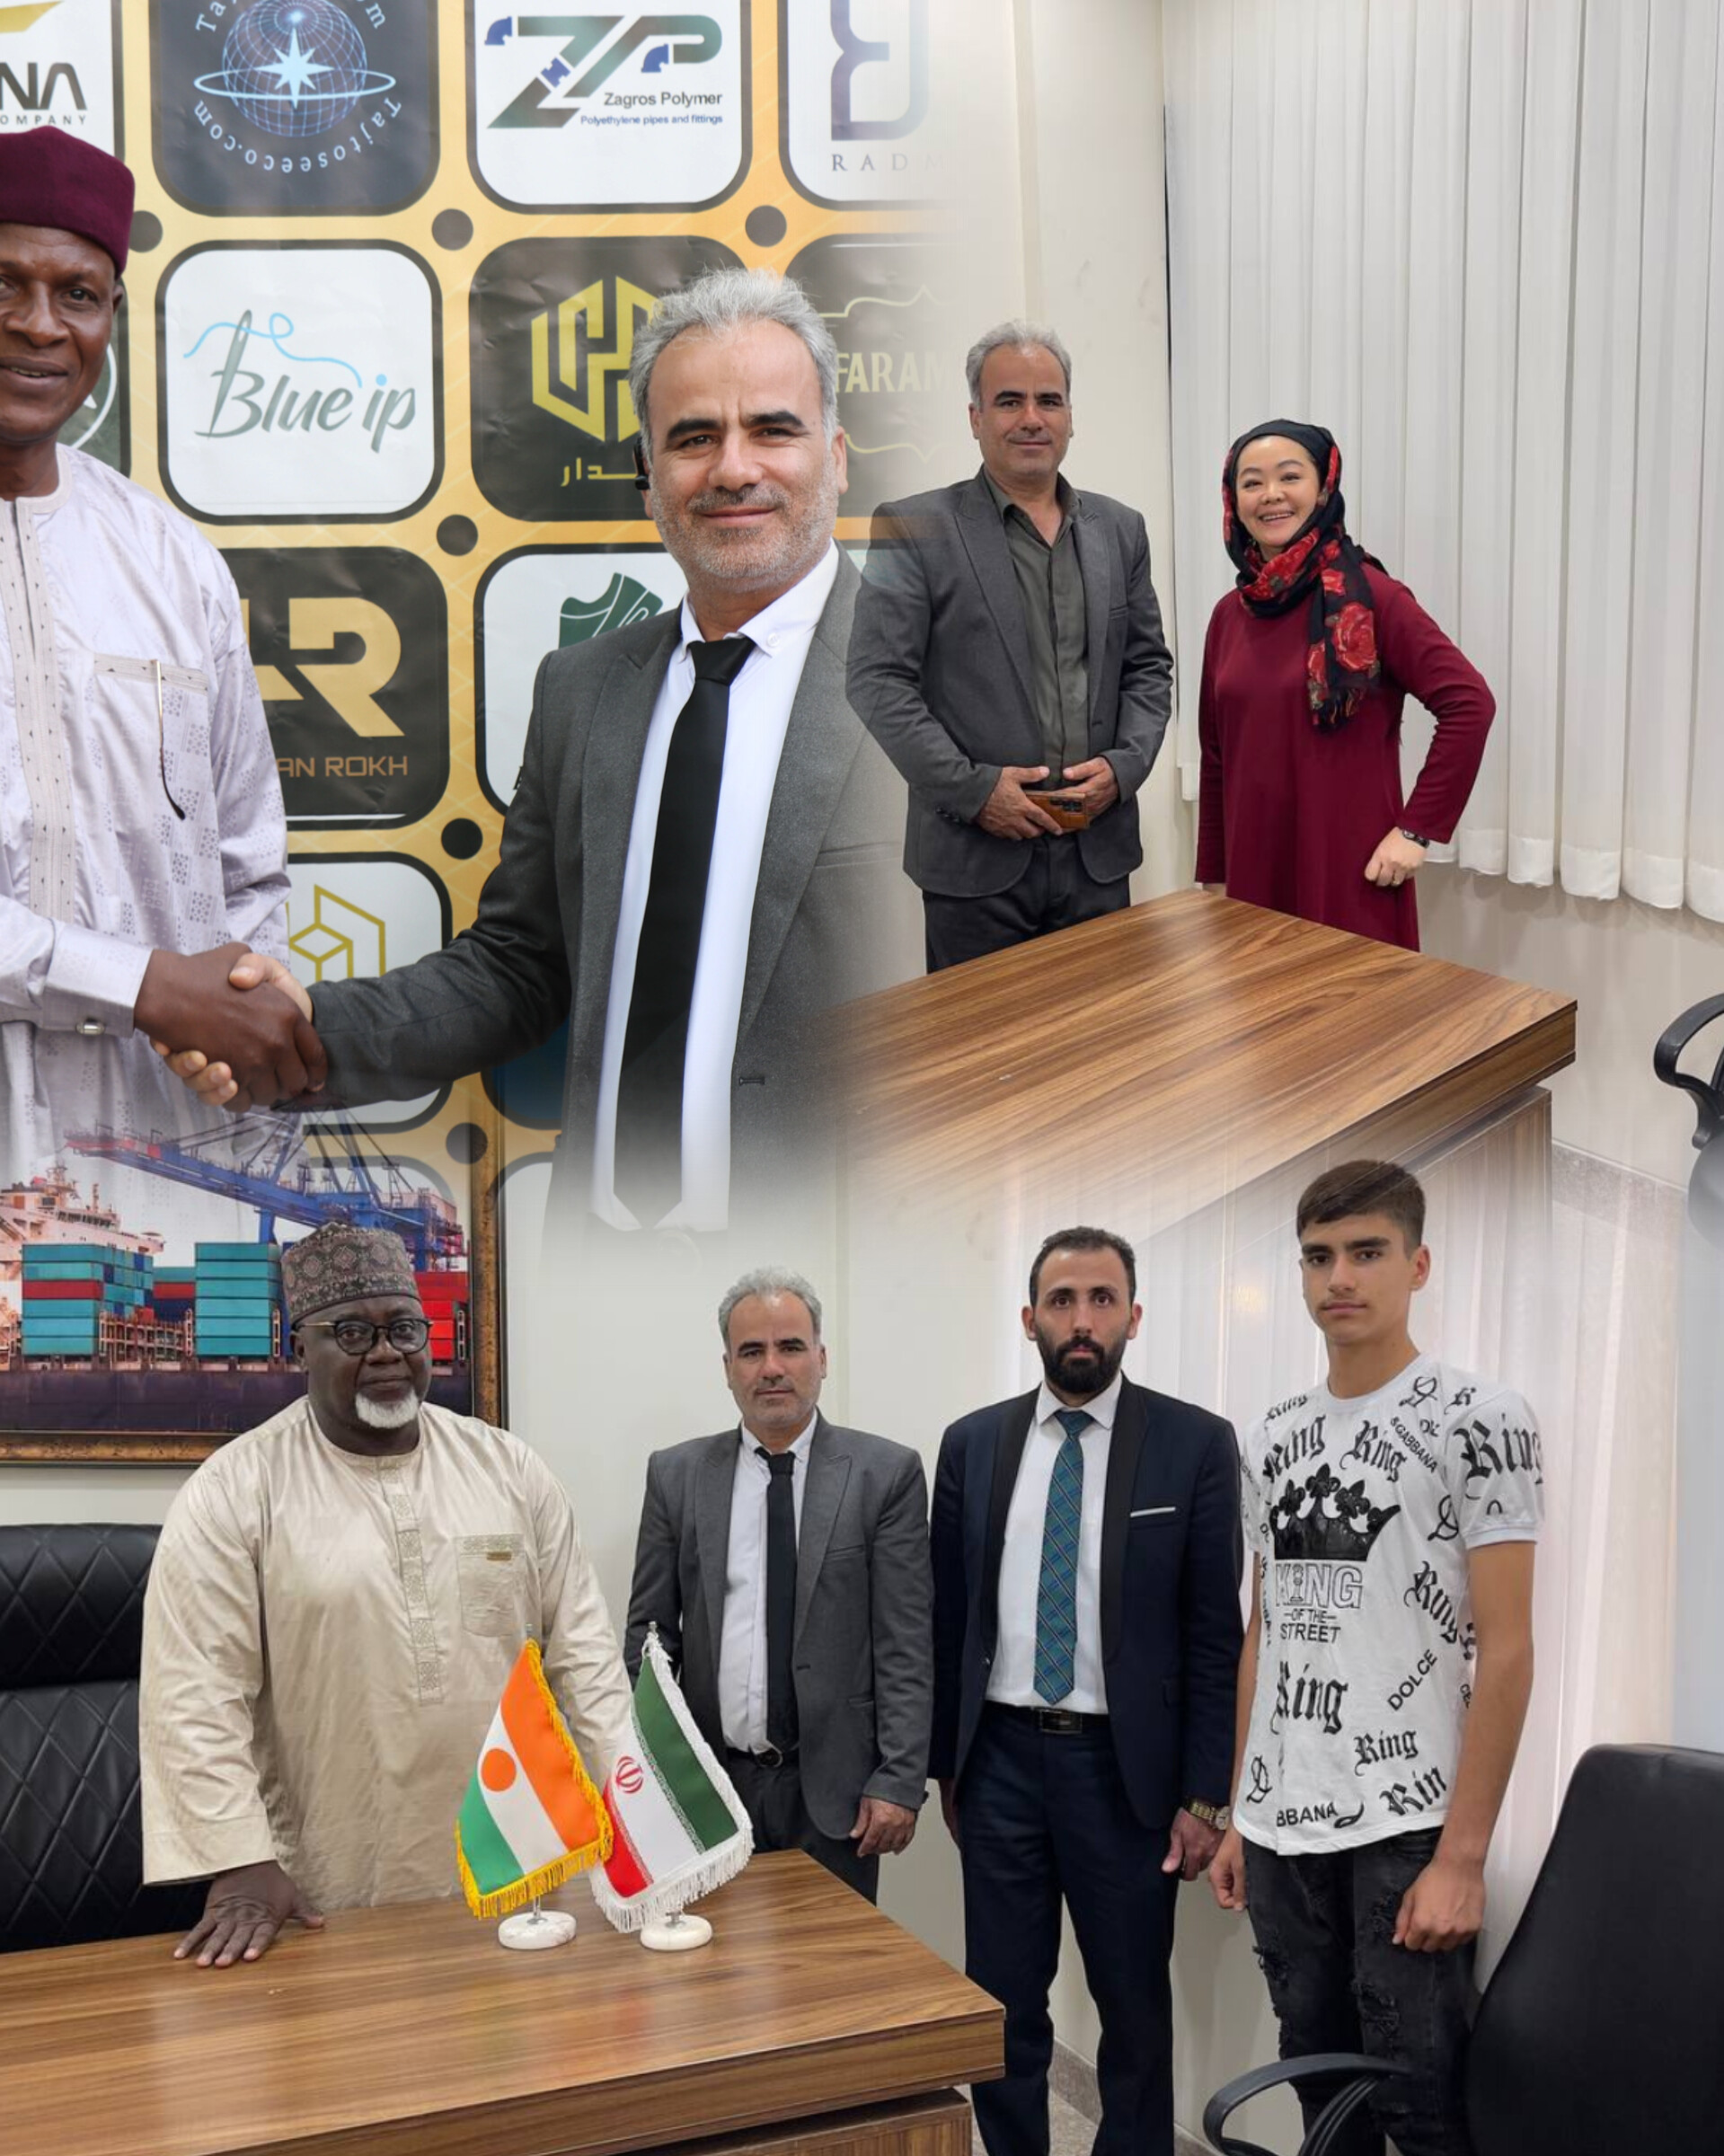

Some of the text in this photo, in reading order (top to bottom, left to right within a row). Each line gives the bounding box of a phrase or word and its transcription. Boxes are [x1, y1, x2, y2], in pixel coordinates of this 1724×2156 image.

[0, 61, 88, 110] NA
[604, 91, 723, 109] Zagros Polymer
[0, 115, 87, 126] OMPANY
[580, 114, 723, 127] Polyethylene pipes and fittings
[194, 309, 417, 455] Blue ip
[277, 755, 408, 778] AN ROKH
[1275, 1563, 1364, 1609] KING
[1279, 1621, 1342, 1644] STREET
[1387, 1648, 1438, 1711] DOLCE
[1276, 1801, 1339, 1828] BBANA
